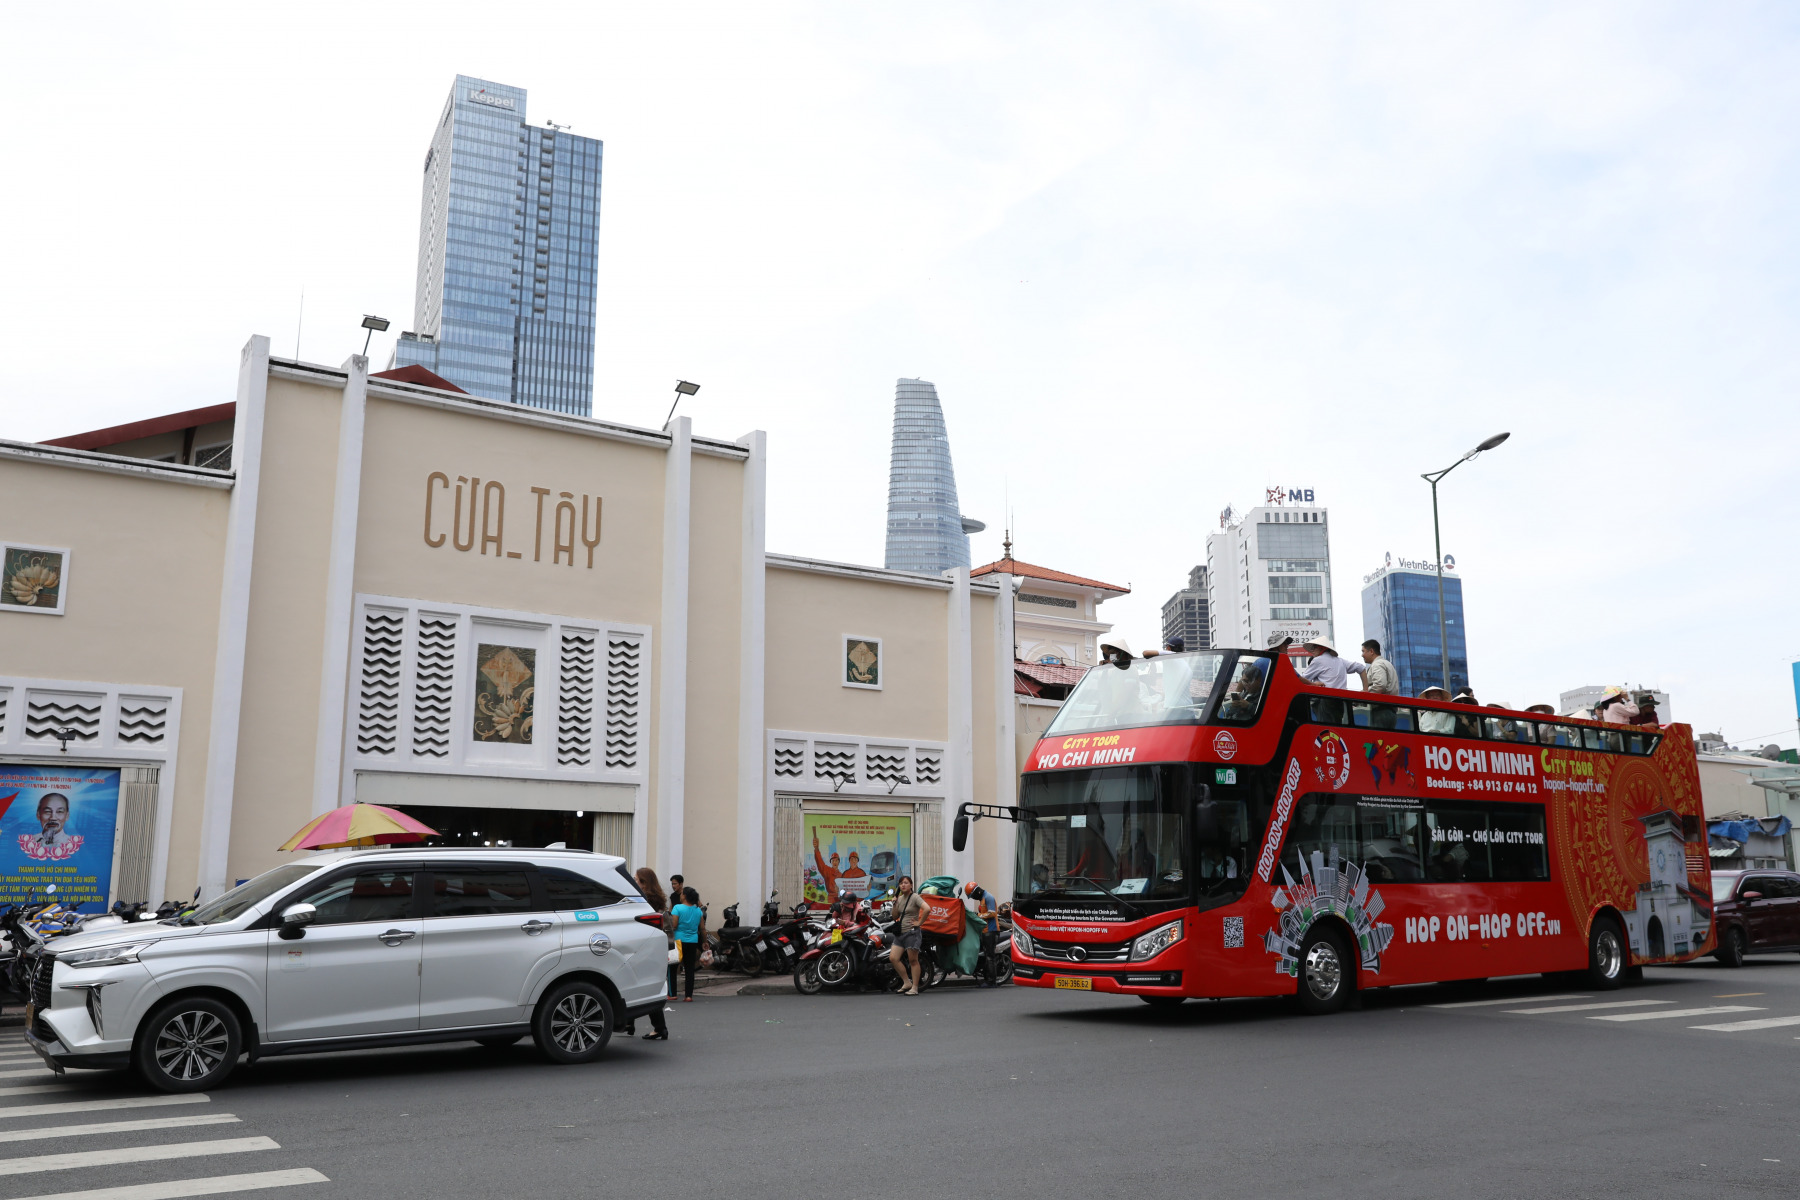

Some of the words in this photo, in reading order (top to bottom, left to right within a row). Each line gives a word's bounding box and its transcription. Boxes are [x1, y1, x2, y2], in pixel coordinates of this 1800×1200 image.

[470, 90, 515, 107] Keppel
[1289, 489, 1315, 502] MB
[1062, 737, 1090, 750] CITY
[1092, 735, 1120, 748] TOUR
[1038, 753, 1060, 769] HO
[1062, 750, 1090, 767] CHI
[1091, 747, 1137, 765] MINH
[1424, 745, 1452, 771] HO
[1456, 748, 1487, 773] CHI
[1490, 751, 1535, 777] MINH
[1540, 748, 1567, 774] CITY
[1569, 760, 1594, 777] TOUR
[1467, 779, 1484, 791] +84
[1486, 780, 1501, 792] 913
[1503, 781, 1514, 793] 67
[1515, 782, 1526, 793] 44
[1528, 783, 1538, 794] 12
[1543, 776, 1605, 795] hopon-hopoff.vn
[1431, 825, 1445, 842] SÀI
[1447, 826, 1464, 842] GÒN
[1472, 829, 1488, 845] CHỢ
[1489, 827, 1505, 843] LỚN
[1506, 831, 1523, 844] CITY
[1524, 832, 1544, 845] TOUR
[930, 906, 949, 917] SPX
[1405, 915, 1441, 944] HOP
